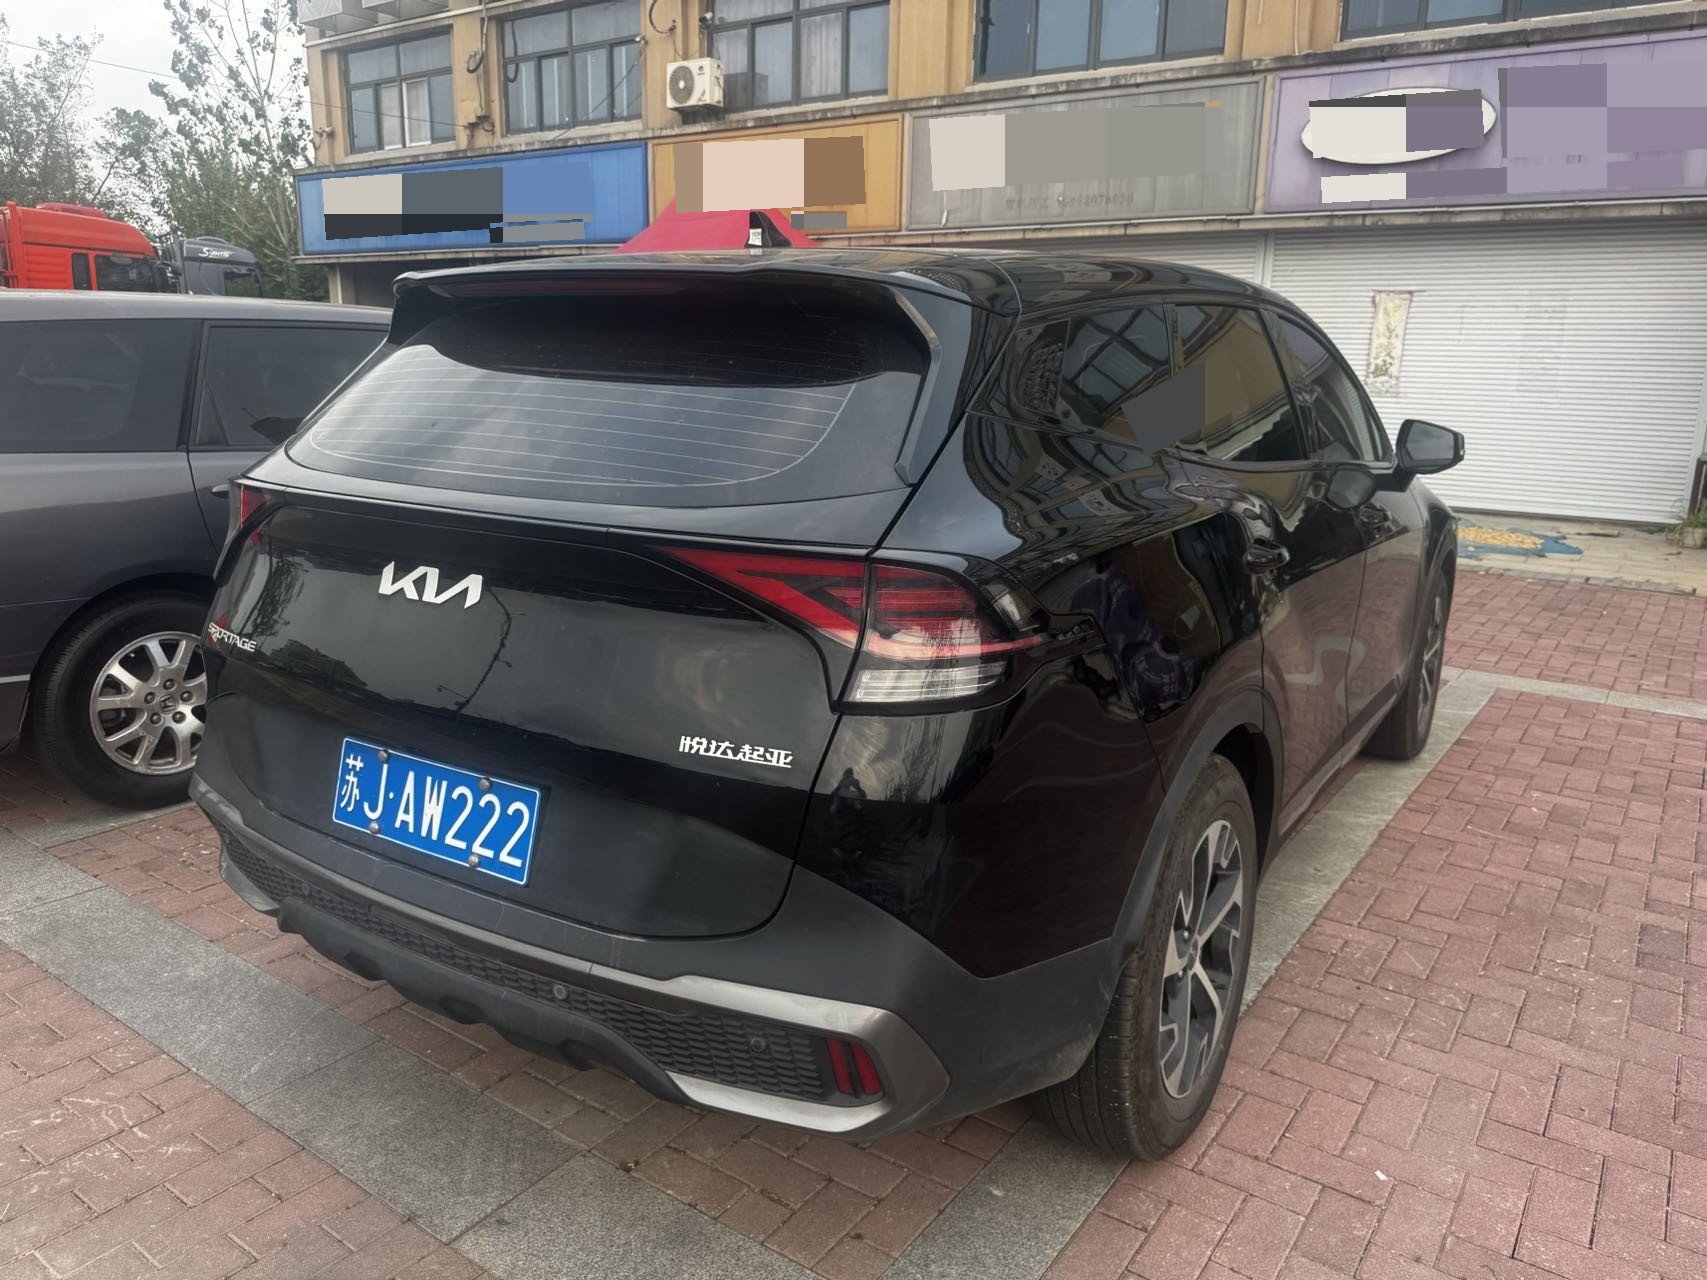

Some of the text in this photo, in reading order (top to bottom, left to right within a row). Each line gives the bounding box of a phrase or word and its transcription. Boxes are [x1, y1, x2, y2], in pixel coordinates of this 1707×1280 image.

[378, 561, 483, 609] KIA
[207, 622, 257, 652] SPORTAGE
[679, 735, 794, 768] 悦达起亚
